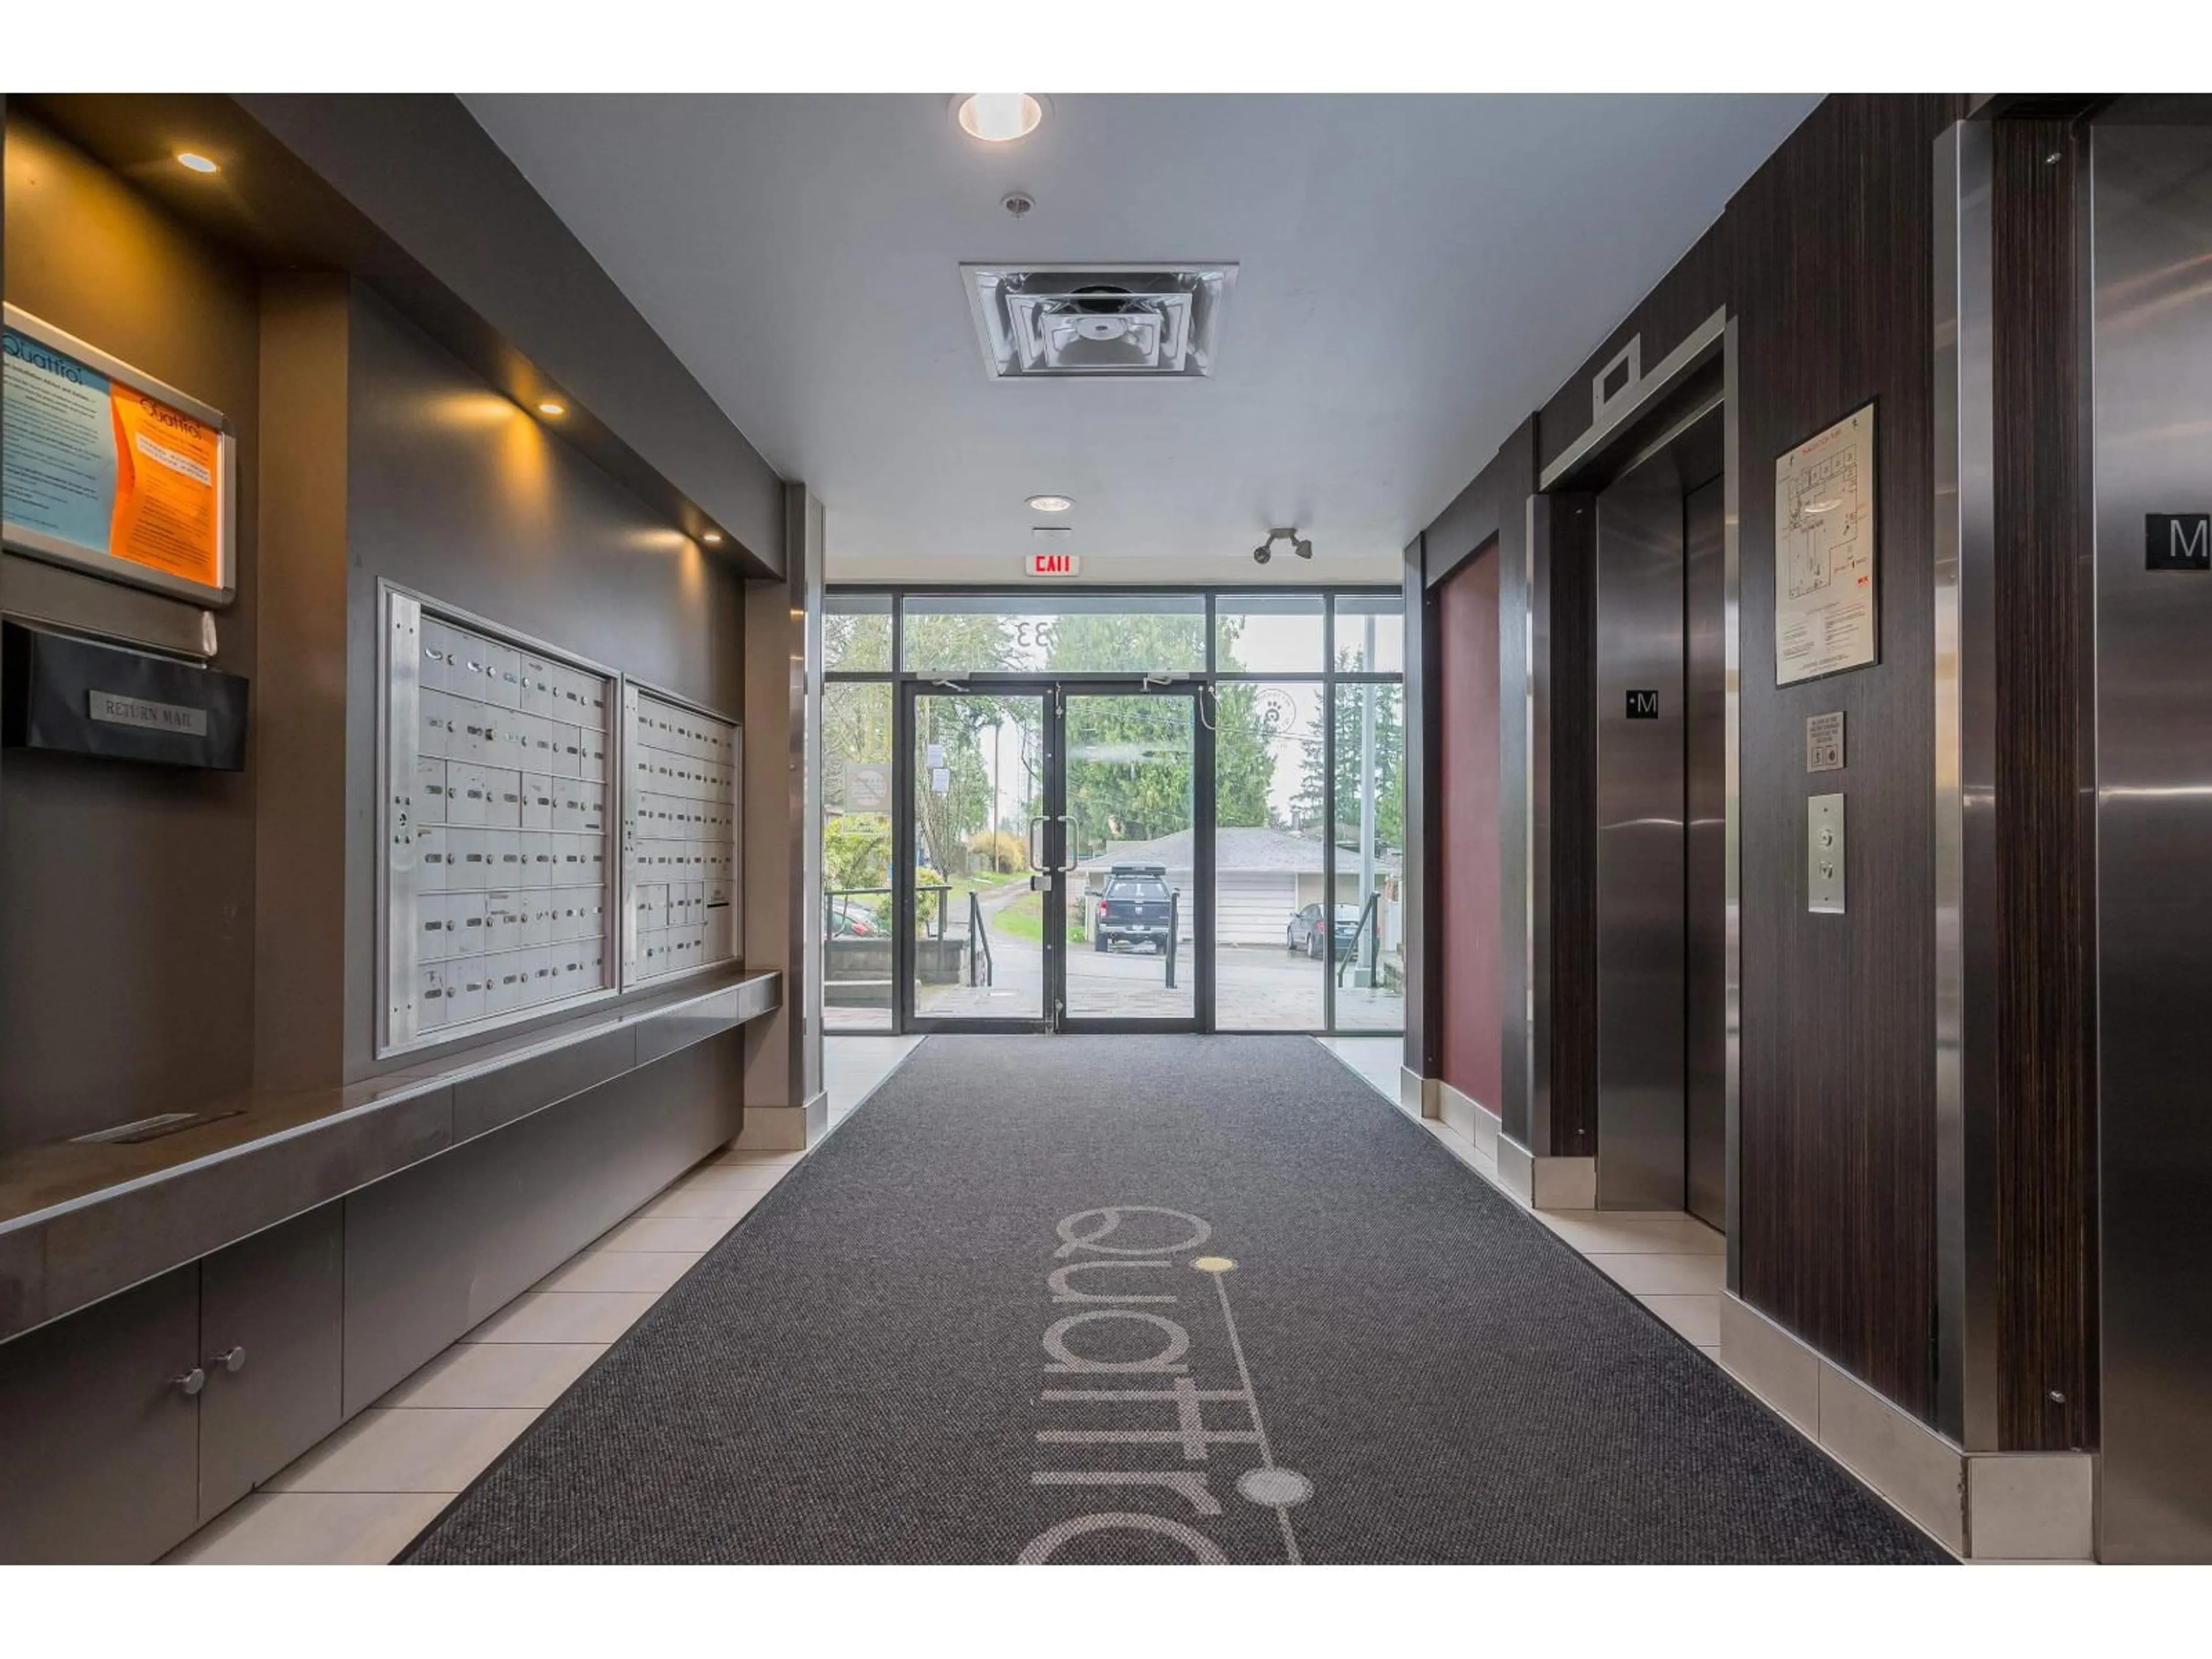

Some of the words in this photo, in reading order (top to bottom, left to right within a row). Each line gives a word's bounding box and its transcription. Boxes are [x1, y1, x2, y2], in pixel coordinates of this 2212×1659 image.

[3, 334, 79, 384] Quattro
[140, 397, 200, 439] Quattro
[2170, 519, 2207, 557] M
[105, 700, 157, 721] RETURN
[162, 710, 192, 728] MAIL
